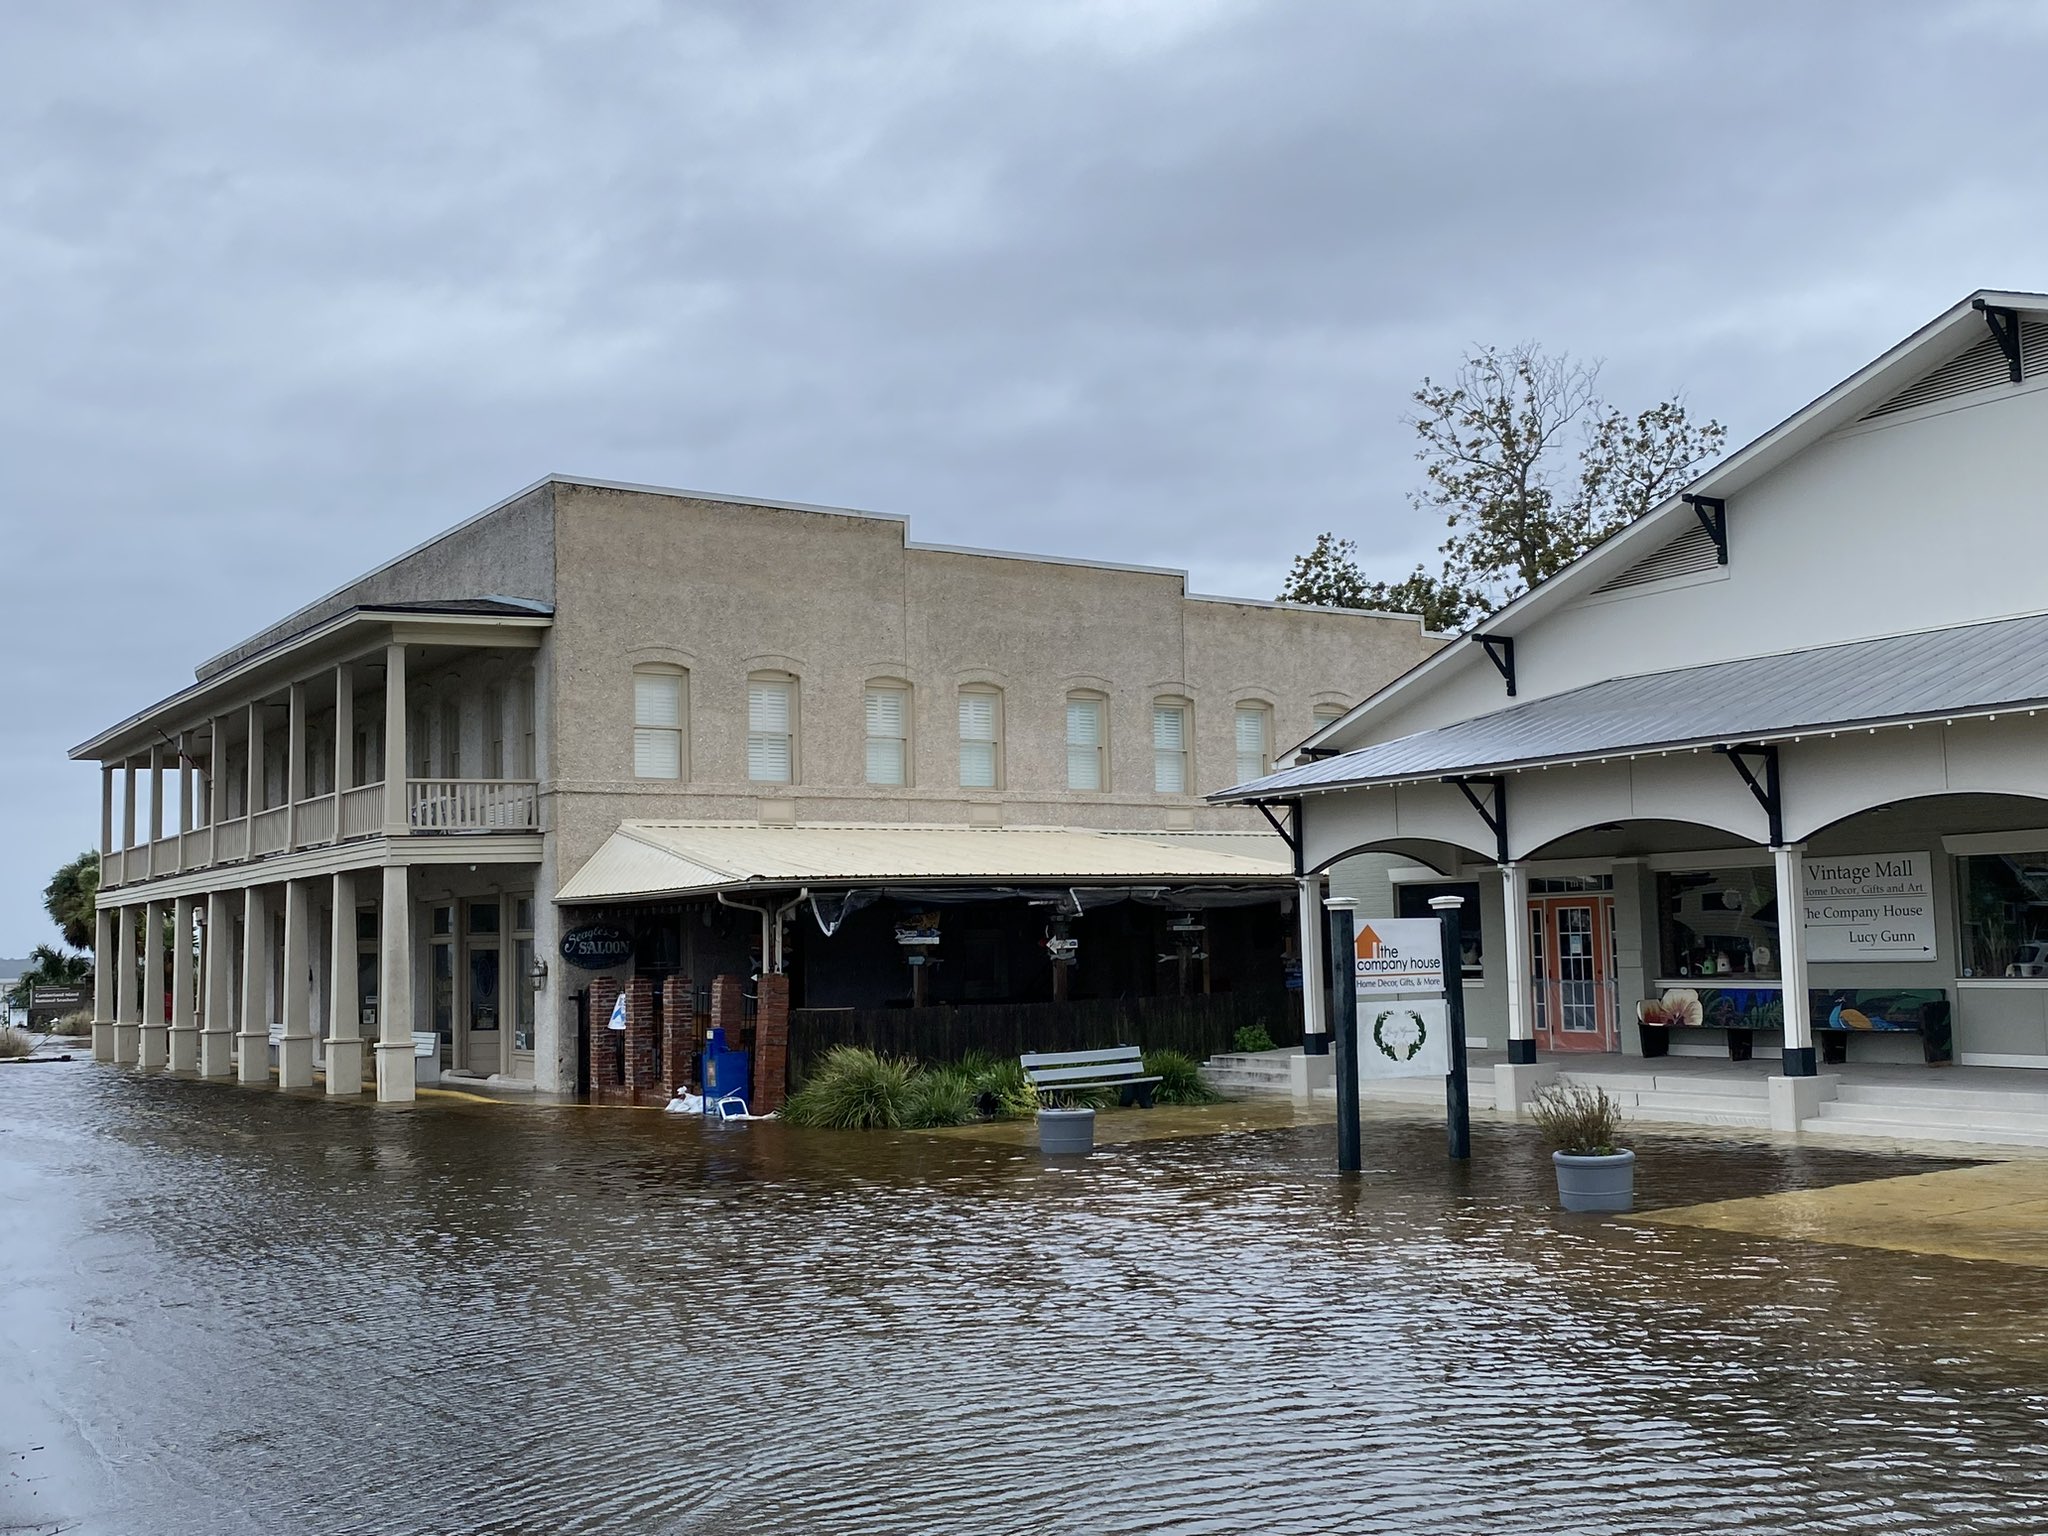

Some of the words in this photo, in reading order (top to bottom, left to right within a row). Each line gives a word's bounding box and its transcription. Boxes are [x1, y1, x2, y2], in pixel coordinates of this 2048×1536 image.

[1808, 864, 1871, 884] Vintage
[1875, 859, 1913, 878] Mall
[1830, 885, 1859, 896] Decor,
[1861, 884, 1884, 894] Gifts
[1886, 883, 1905, 893] and
[1907, 882, 1923, 892] Art
[1823, 906, 1880, 921] Company
[1883, 905, 1923, 917] House
[1849, 930, 1877, 946] Lucy
[1880, 930, 1916, 942] Gunn
[578, 941, 631, 955] SALOON
[1380, 945, 1399, 959] the
[1356, 959, 1409, 973] company
[1410, 956, 1441, 969] house
[1356, 979, 1376, 988] Home
[1378, 978, 1398, 988] Decor,
[1416, 977, 1422, 986] &
[1424, 977, 1440, 986] More
